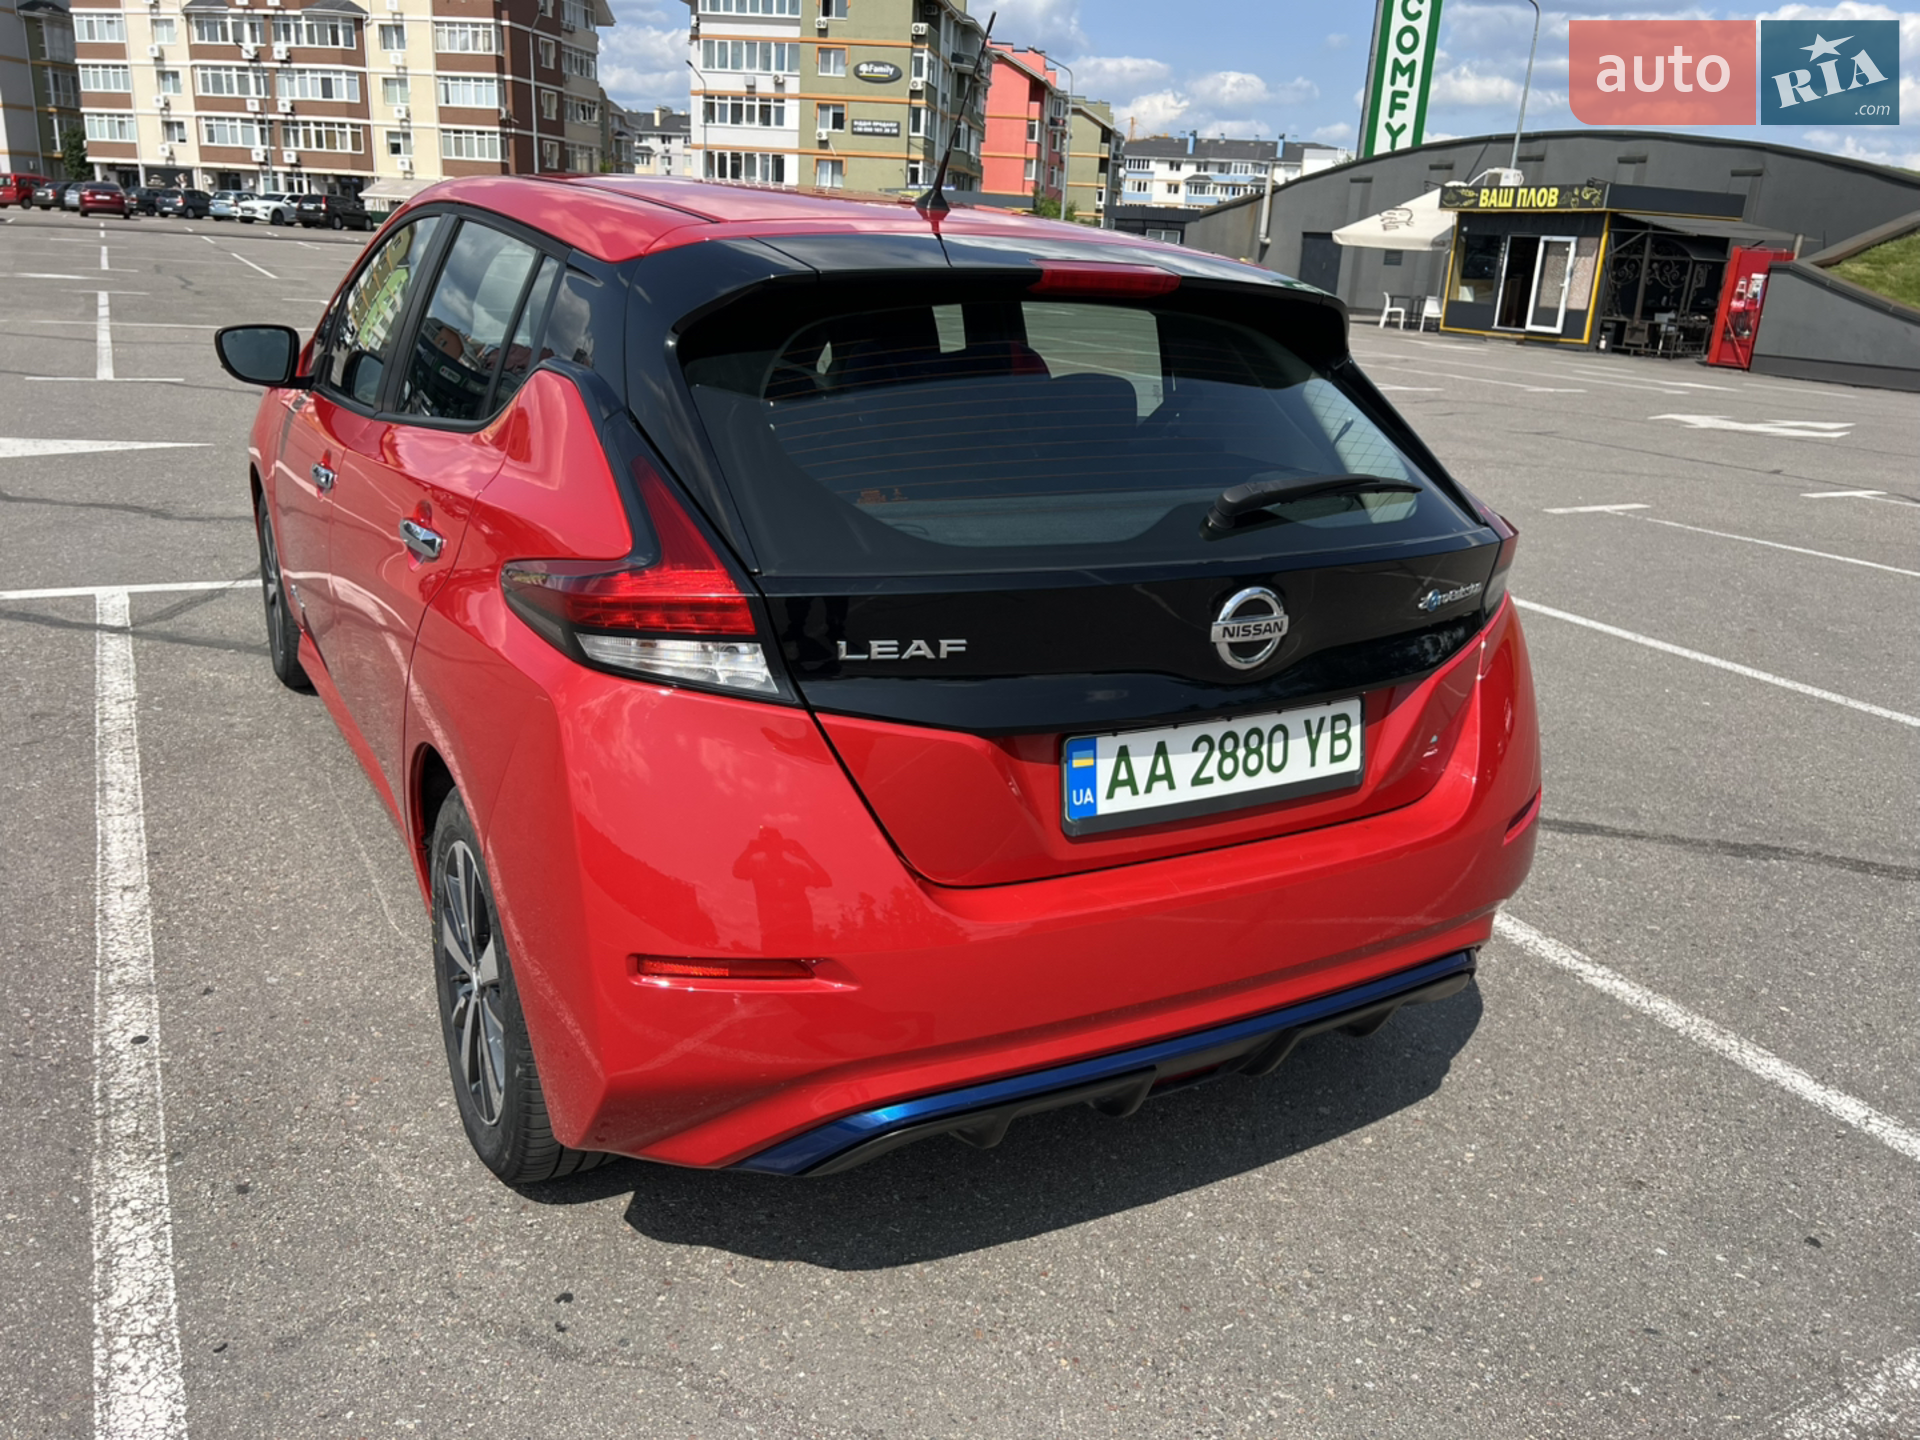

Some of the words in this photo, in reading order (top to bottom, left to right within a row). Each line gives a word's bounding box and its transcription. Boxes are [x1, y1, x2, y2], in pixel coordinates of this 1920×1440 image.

[868, 63, 895, 75] Family
[1385, 0, 1425, 152] COMFY
[1478, 188, 1515, 208] ВАШ
[1516, 187, 1559, 208] ПЛОВ
[1222, 620, 1284, 639] NISSAN
[836, 639, 968, 660] LEAF
[1105, 740, 1177, 800] AA
[1190, 723, 1290, 788] 2880
[1303, 712, 1353, 769] YB
[1072, 787, 1095, 806] UA
